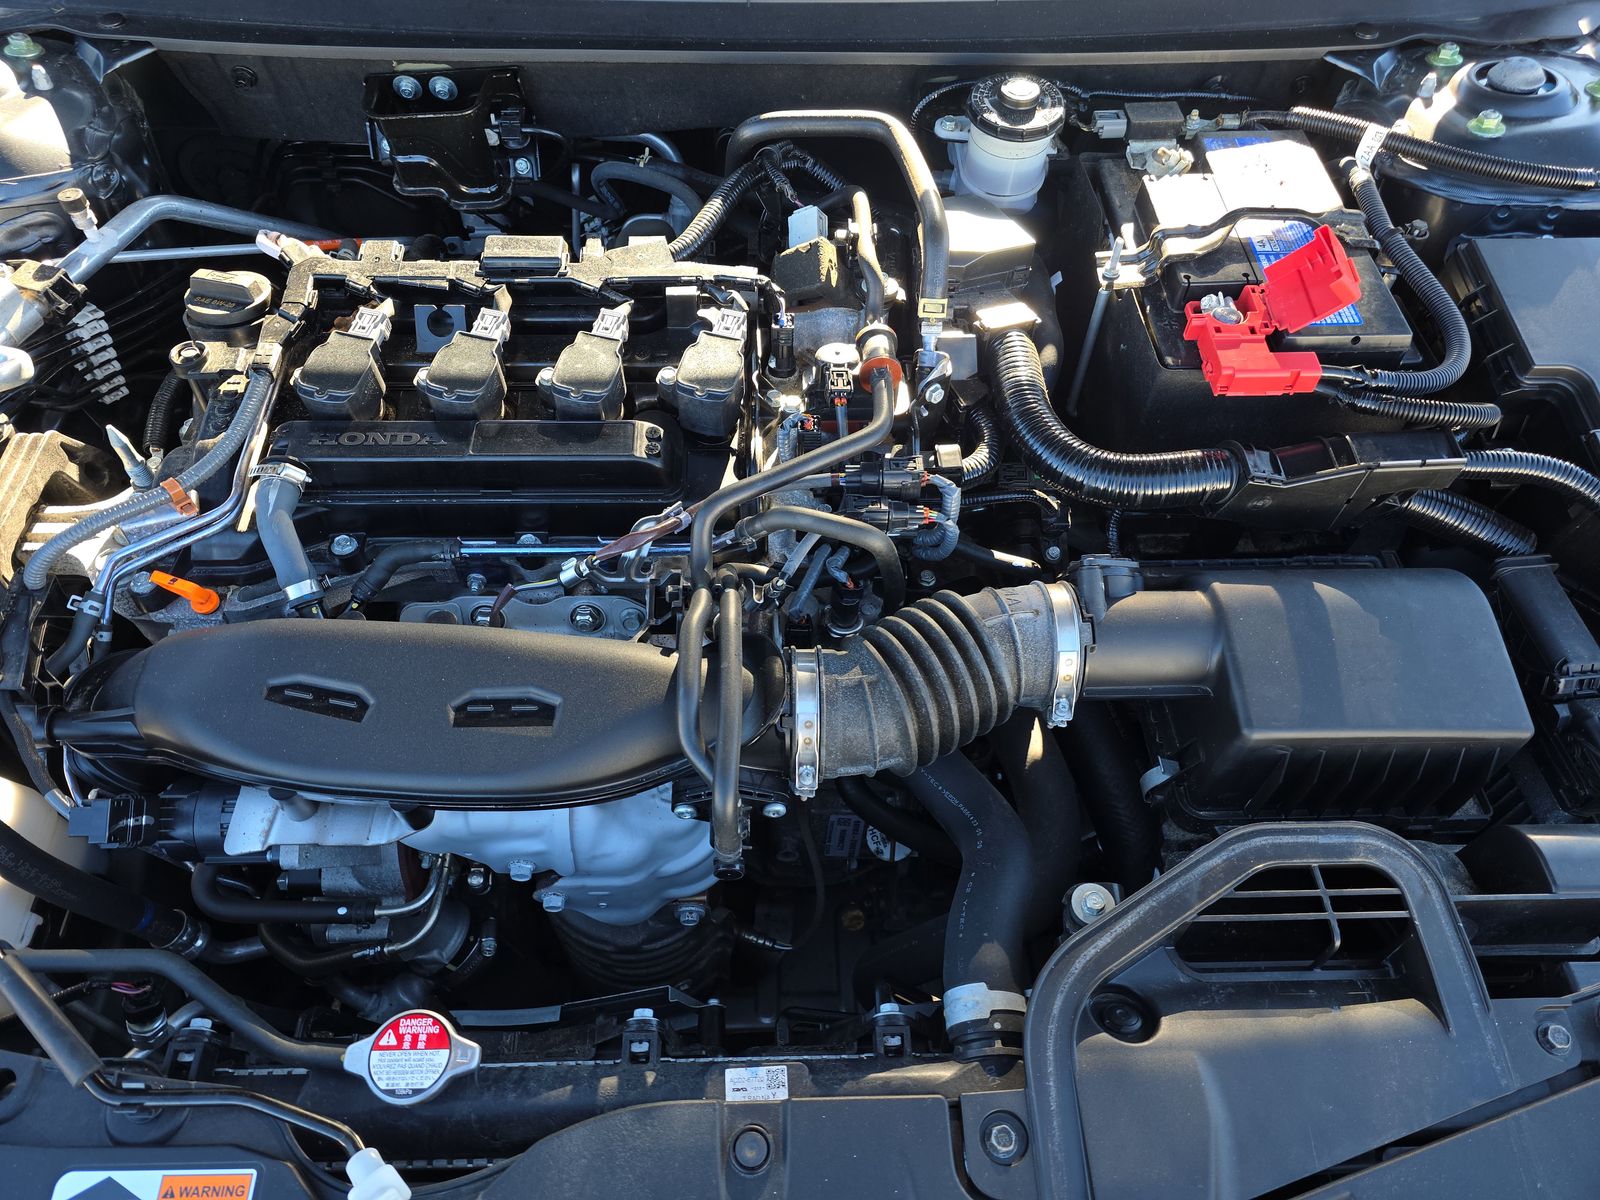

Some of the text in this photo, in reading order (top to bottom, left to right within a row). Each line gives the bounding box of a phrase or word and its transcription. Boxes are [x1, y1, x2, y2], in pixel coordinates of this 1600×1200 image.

[307, 431, 448, 446] HONDA
[400, 1018, 433, 1026] DANGER
[399, 1026, 440, 1034] WARNUNG
[178, 1184, 246, 1199] WARNING
